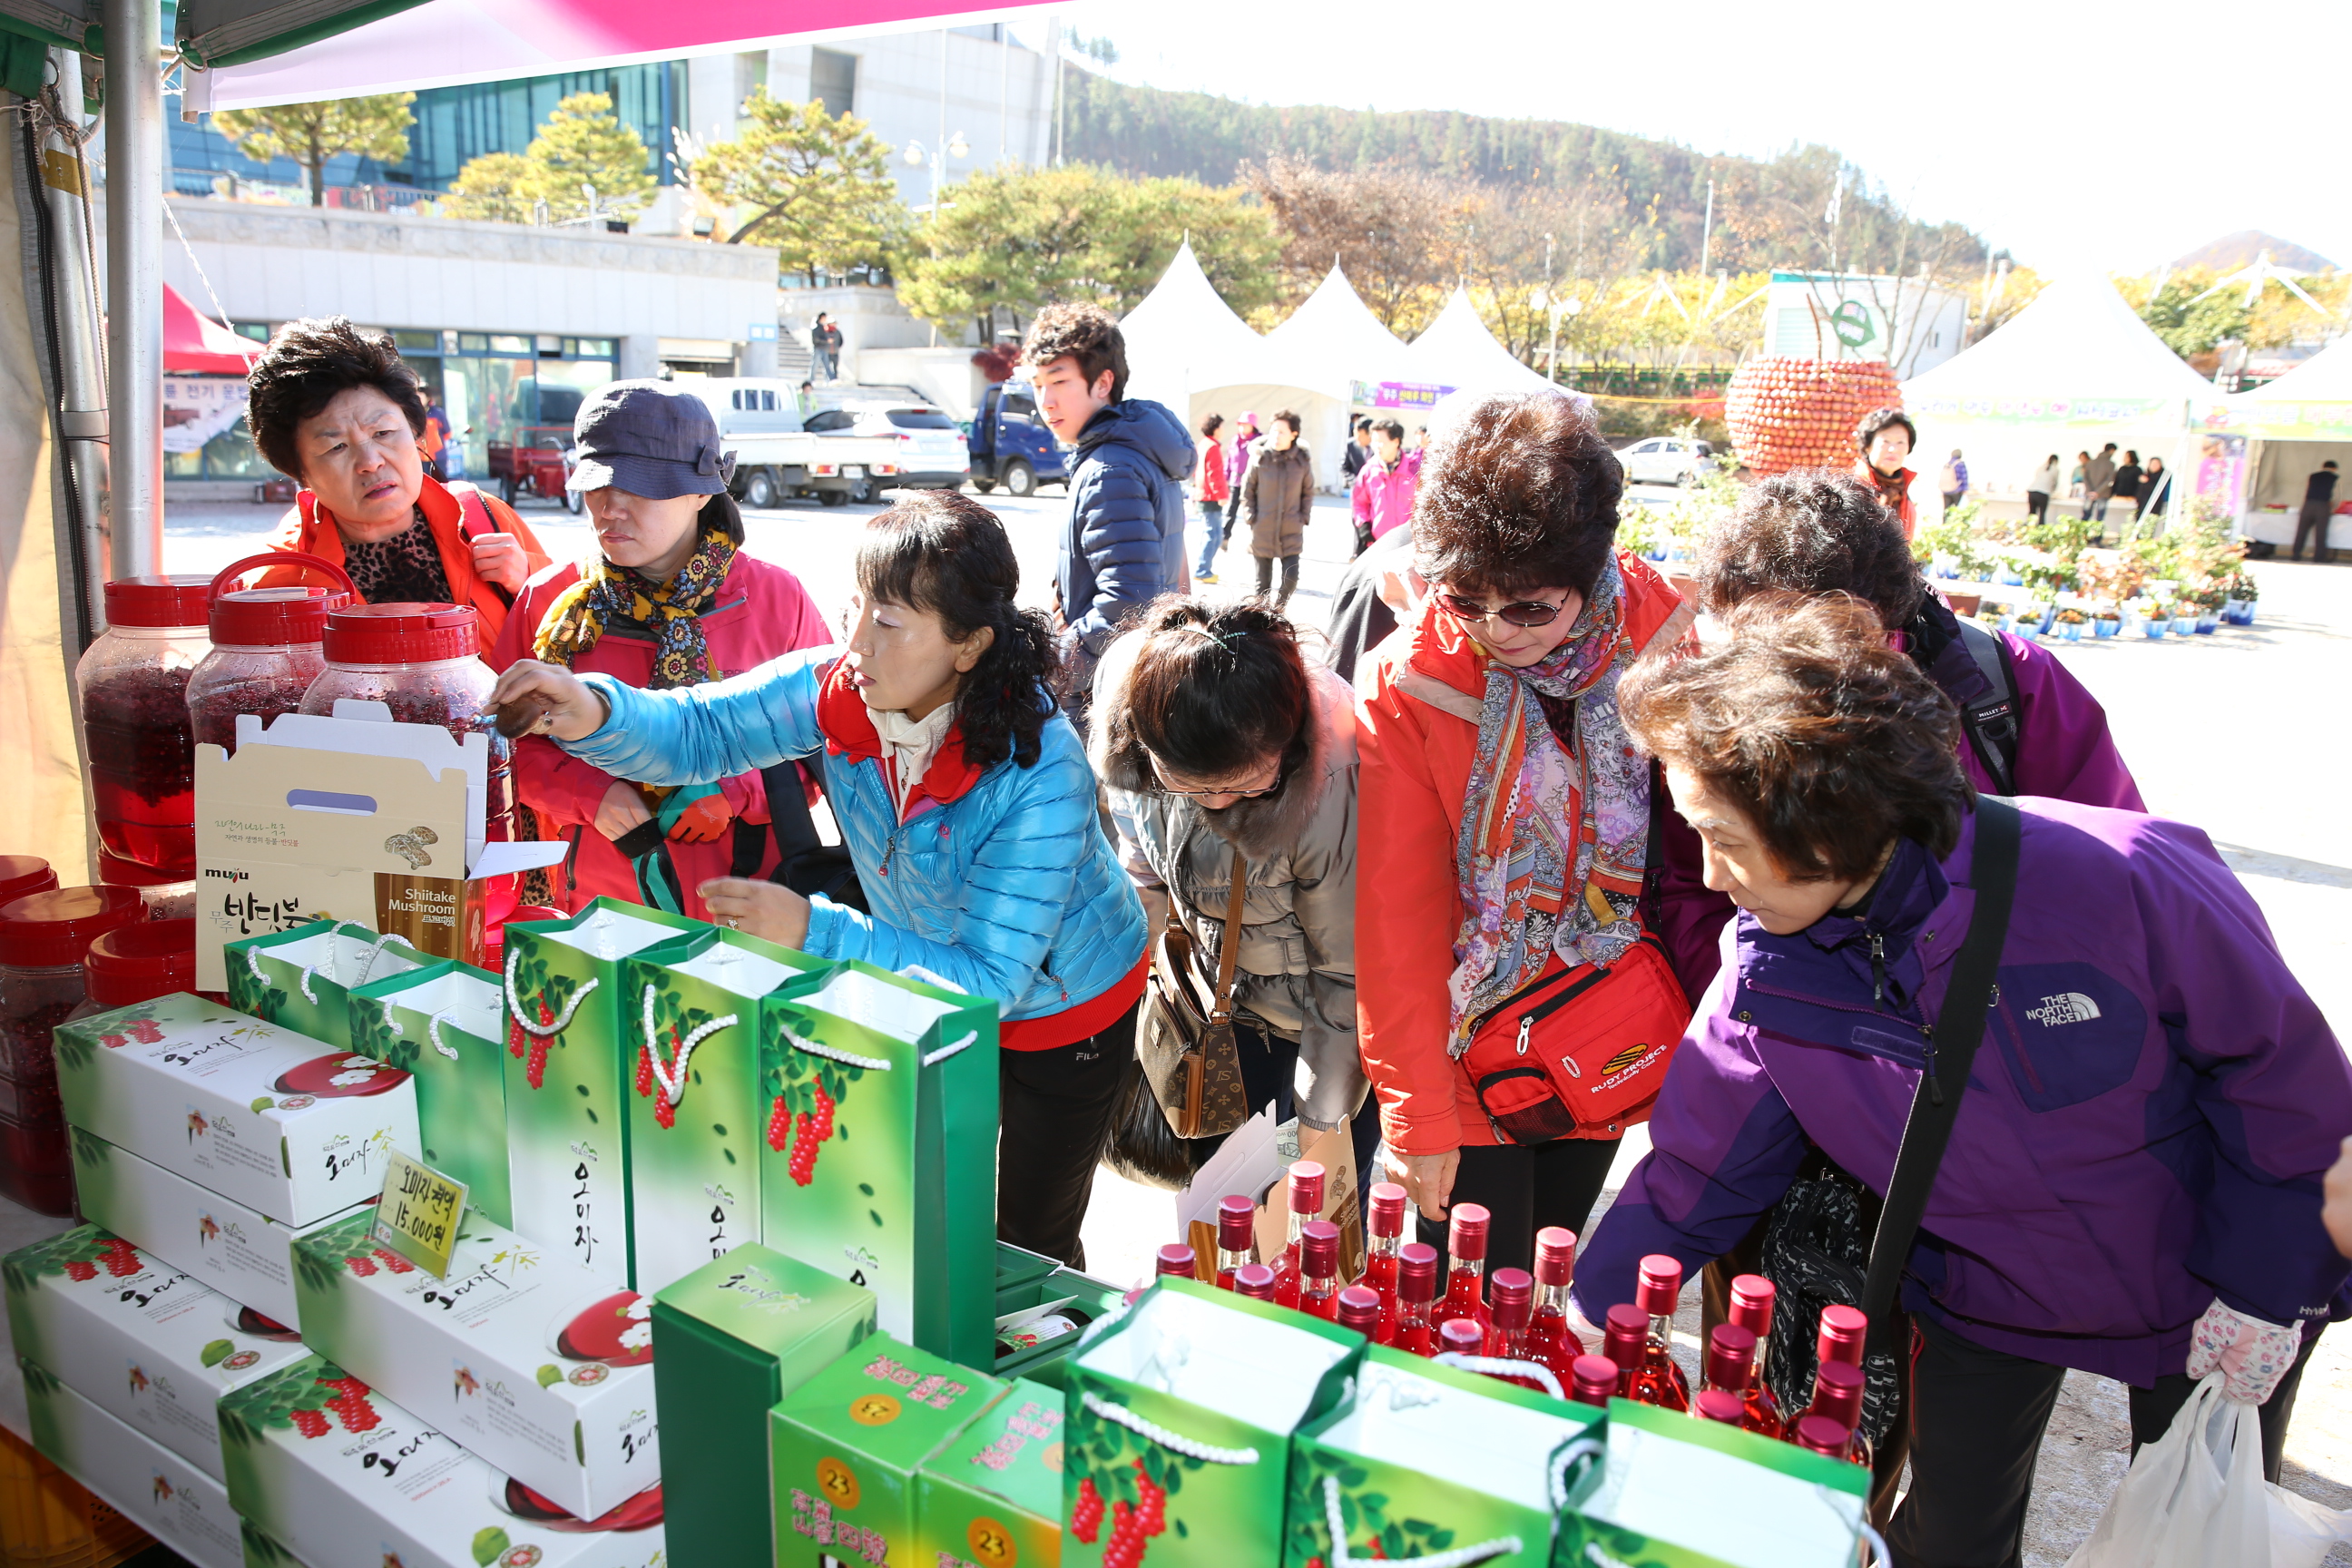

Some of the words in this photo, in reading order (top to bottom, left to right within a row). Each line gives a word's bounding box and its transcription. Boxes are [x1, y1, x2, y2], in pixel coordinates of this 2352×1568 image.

[1978, 708, 1999, 718] MILLET
[205, 867, 250, 884] muju
[405, 888, 456, 904] Shiitake
[388, 898, 456, 916] Mushroom
[422, 915, 456, 926] 표고버섯
[2040, 993, 2069, 1008] THE
[2025, 1003, 2073, 1021] NORTH
[2042, 1012, 2076, 1027] FACE
[1075, 1052, 1100, 1061] FILA
[1591, 1073, 1621, 1093] RUDY
[1622, 1044, 1667, 1076] PROJECT
[1607, 1068, 1640, 1090] Technically
[1641, 1058, 1656, 1070] Cool
[326, 1139, 371, 1181] 오미자
[399, 1165, 432, 1203] 오미자
[573, 1161, 599, 1264] 오미자
[424, 1263, 510, 1310] 오미자
[827, 1468, 850, 1496] 23
[978, 1529, 1006, 1558] 23
